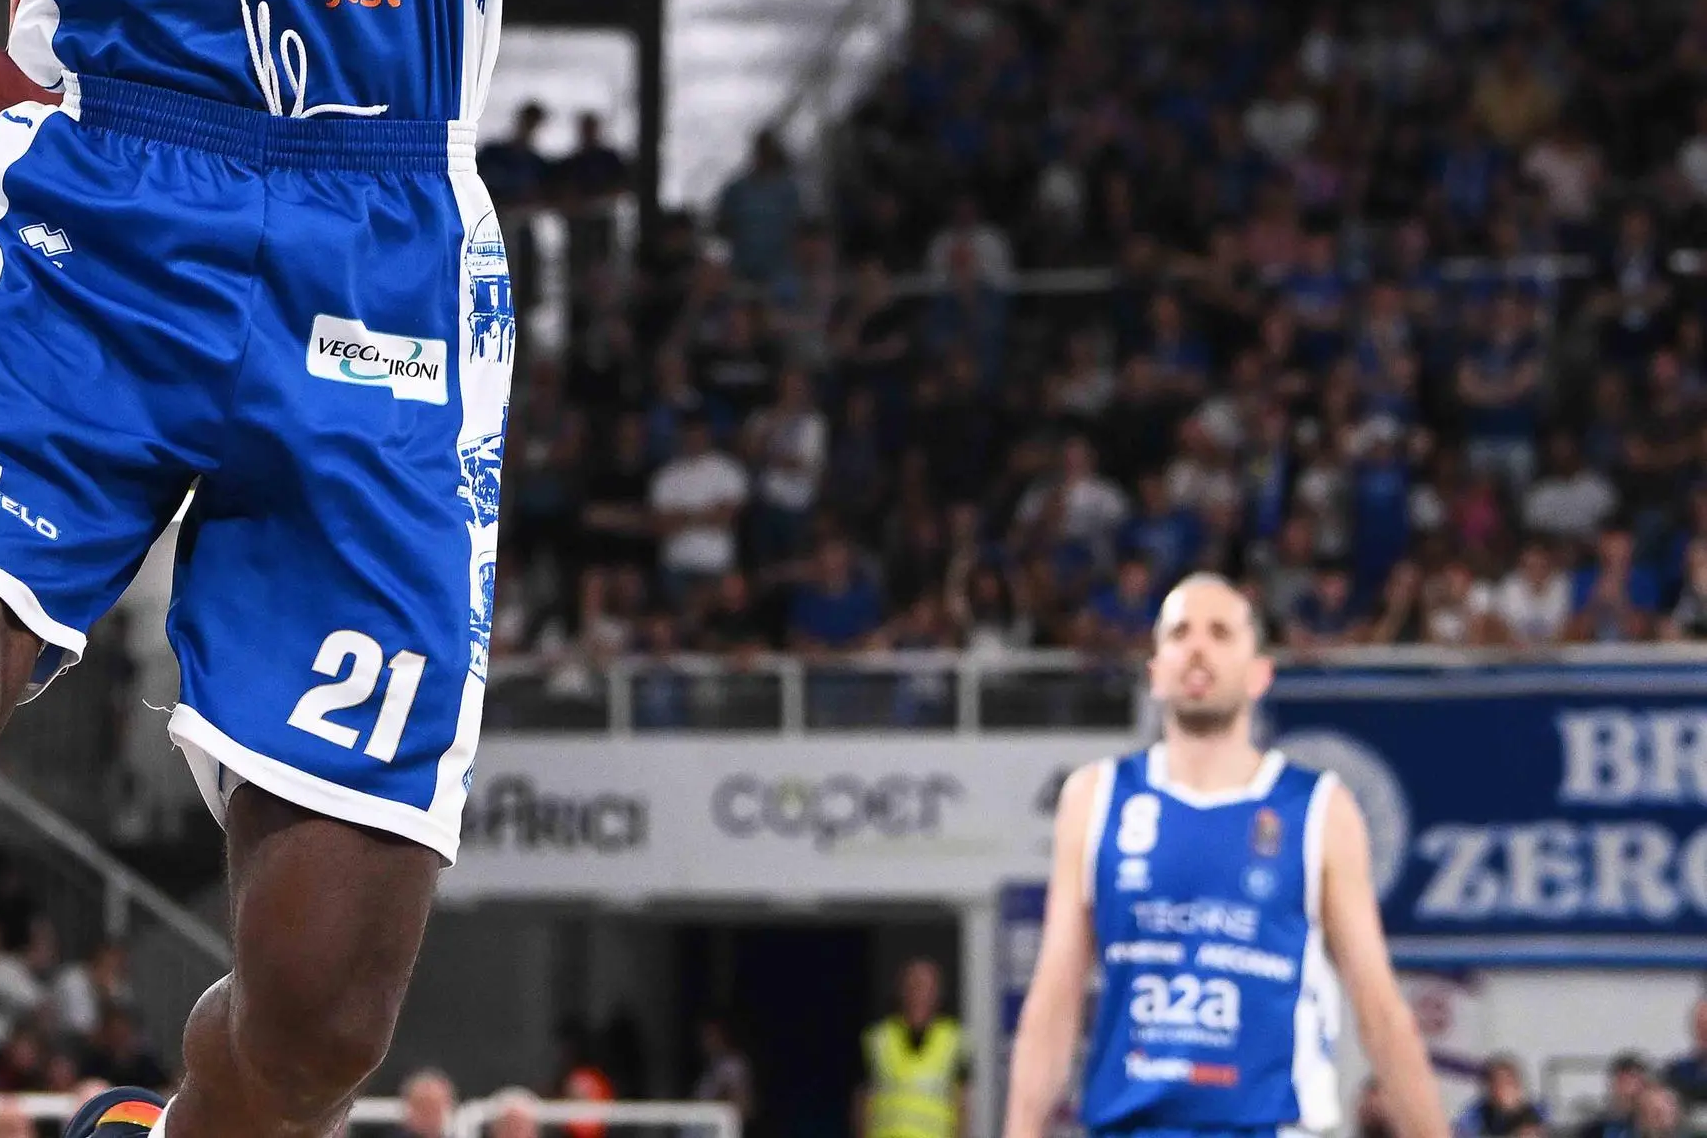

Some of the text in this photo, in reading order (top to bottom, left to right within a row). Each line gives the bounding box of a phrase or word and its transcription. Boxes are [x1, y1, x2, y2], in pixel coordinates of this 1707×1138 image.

[286, 629, 428, 763] 21
[1116, 792, 1161, 855] 8
[1129, 973, 1241, 1033] a2a
